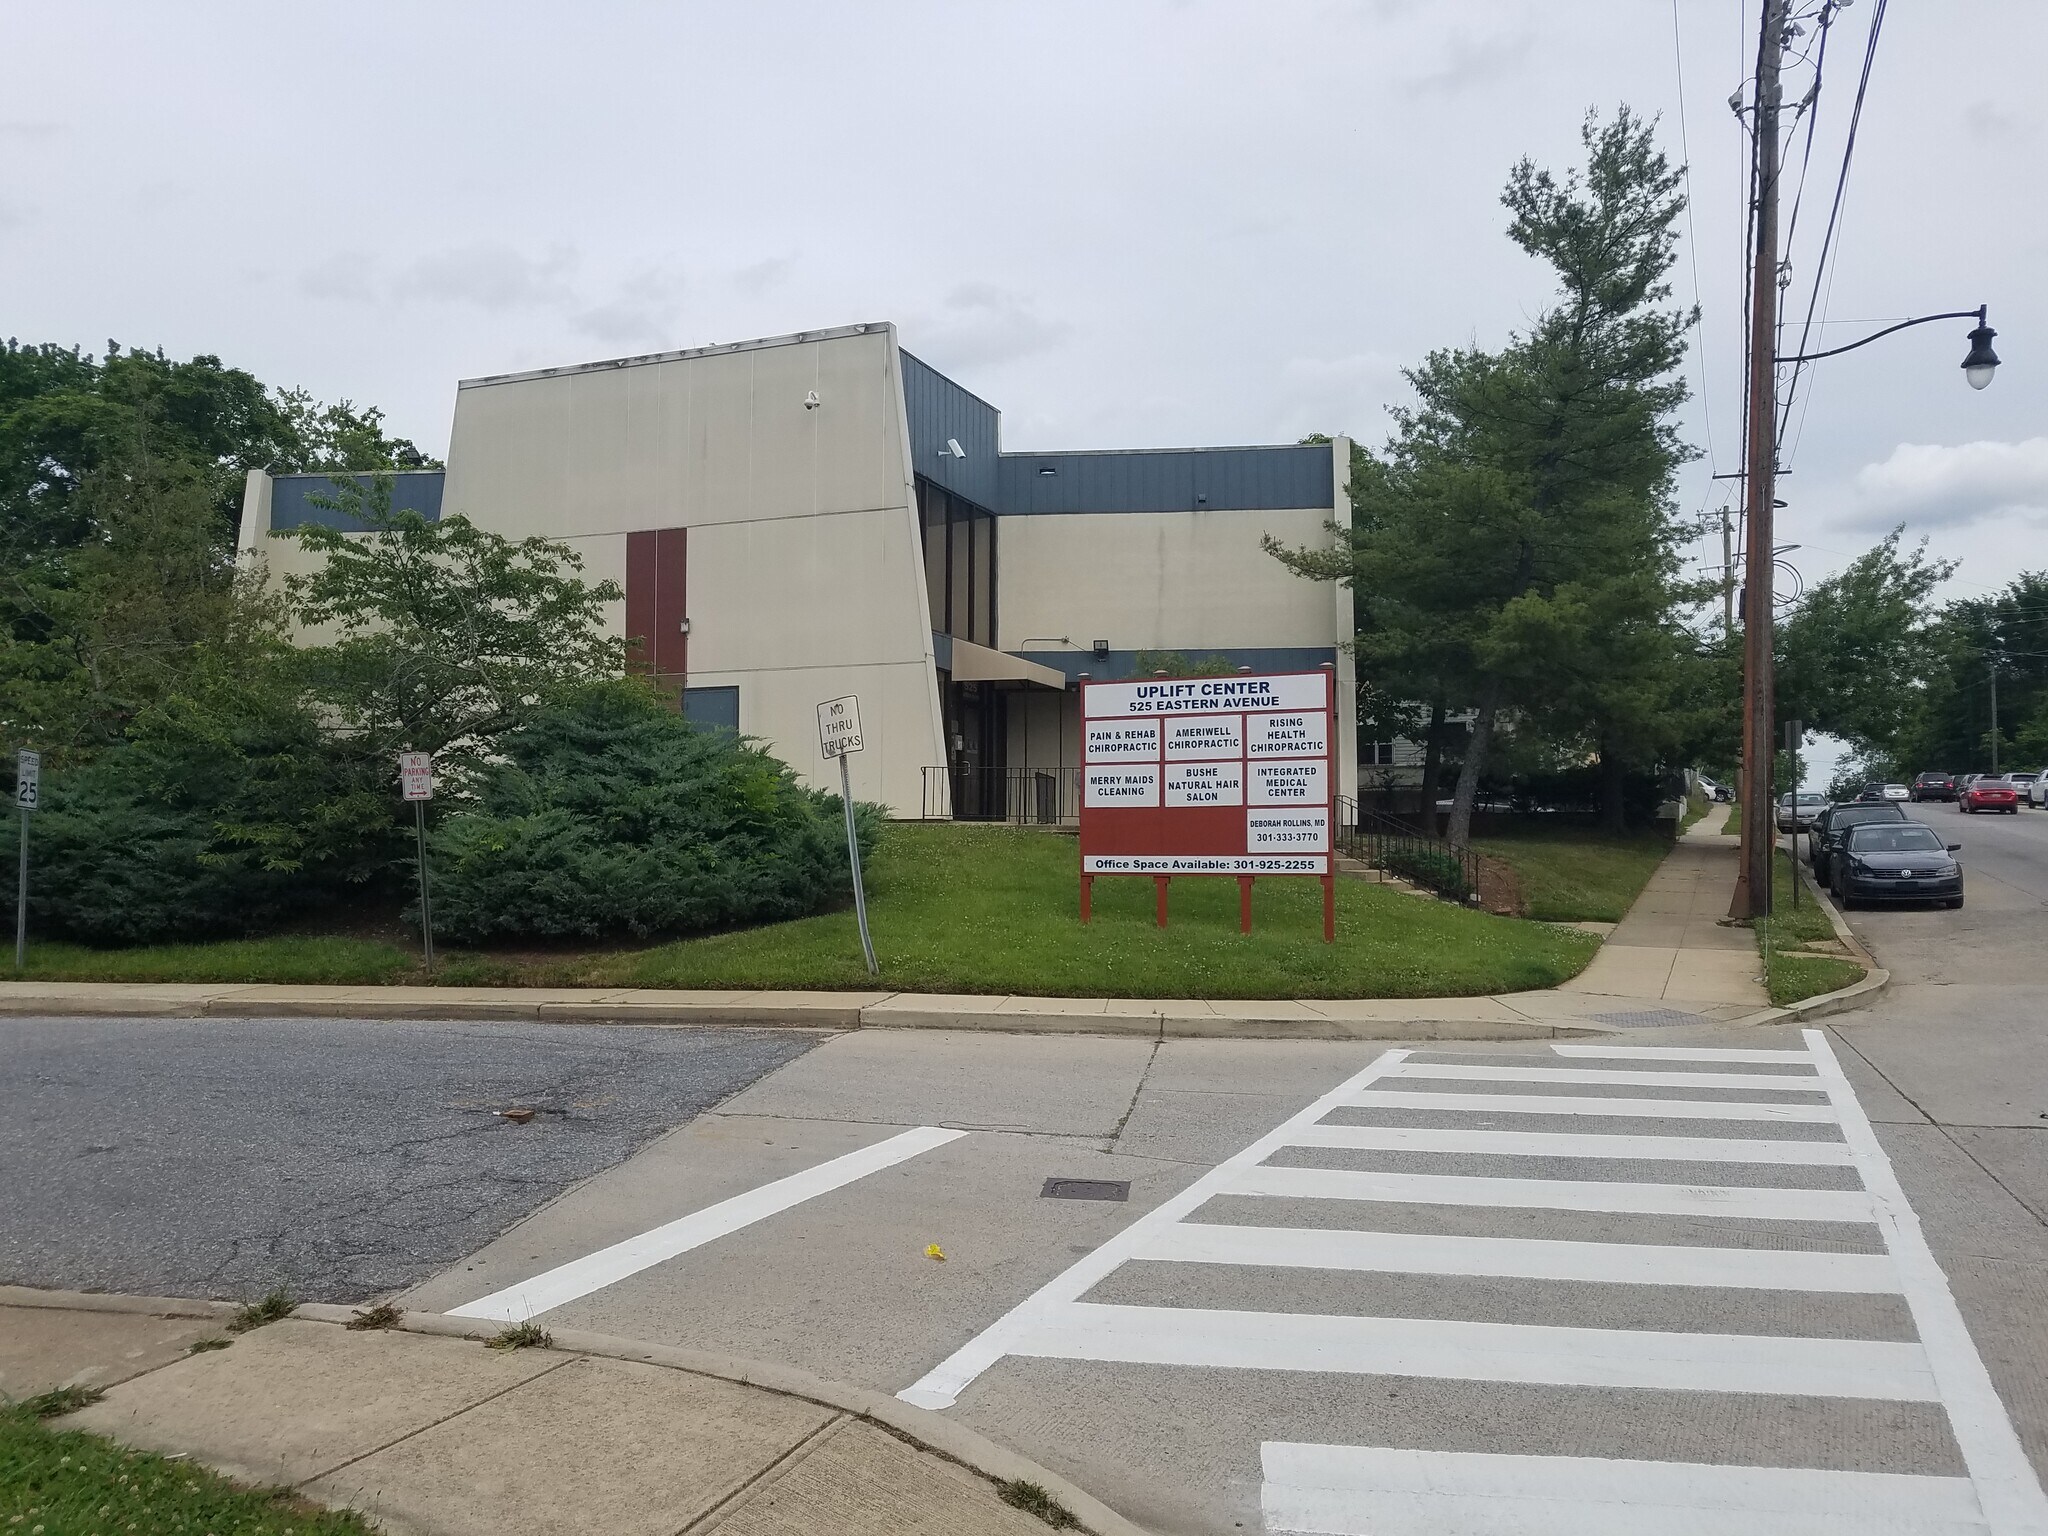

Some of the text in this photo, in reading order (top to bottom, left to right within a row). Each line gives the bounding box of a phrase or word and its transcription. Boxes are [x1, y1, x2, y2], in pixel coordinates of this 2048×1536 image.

[1137, 681, 1271, 699] UPLIFT CENTER
[1129, 696, 1280, 712] 525 EASTERN AVENUE
[830, 704, 844, 717] NO
[826, 719, 853, 735] THRU
[1269, 718, 1303, 728] RISING
[1090, 729, 1156, 741] PAIN & REHAB
[1175, 727, 1231, 738] AMERIWELL
[1267, 730, 1306, 740] HEALTH
[823, 735, 861, 752] TRUCKS
[1088, 742, 1157, 753] CHIROPRACTIC
[1168, 738, 1240, 750] CHIROPRACTIC
[1250, 741, 1324, 753] CHIROPRACTIC
[410, 757, 421, 766] NO
[404, 767, 429, 776] PARKING
[1186, 768, 1218, 777] BUSHE
[1257, 767, 1317, 777] INTEGRATED
[1090, 775, 1154, 785] MERRY MAIDS
[1168, 779, 1239, 791] NATURAL HAIR
[1266, 778, 1308, 788] MEDICAL
[19, 781, 37, 803] 25
[1097, 787, 1145, 796] CLEANING
[1268, 788, 1306, 797] CENTER
[1186, 792, 1218, 802] SALON
[1250, 819, 1325, 828] DEBORAH ROLLINS, MD
[1256, 832, 1319, 842] 301-333-3770
[1095, 859, 1315, 871] Office Space Available: 301-925-2255
